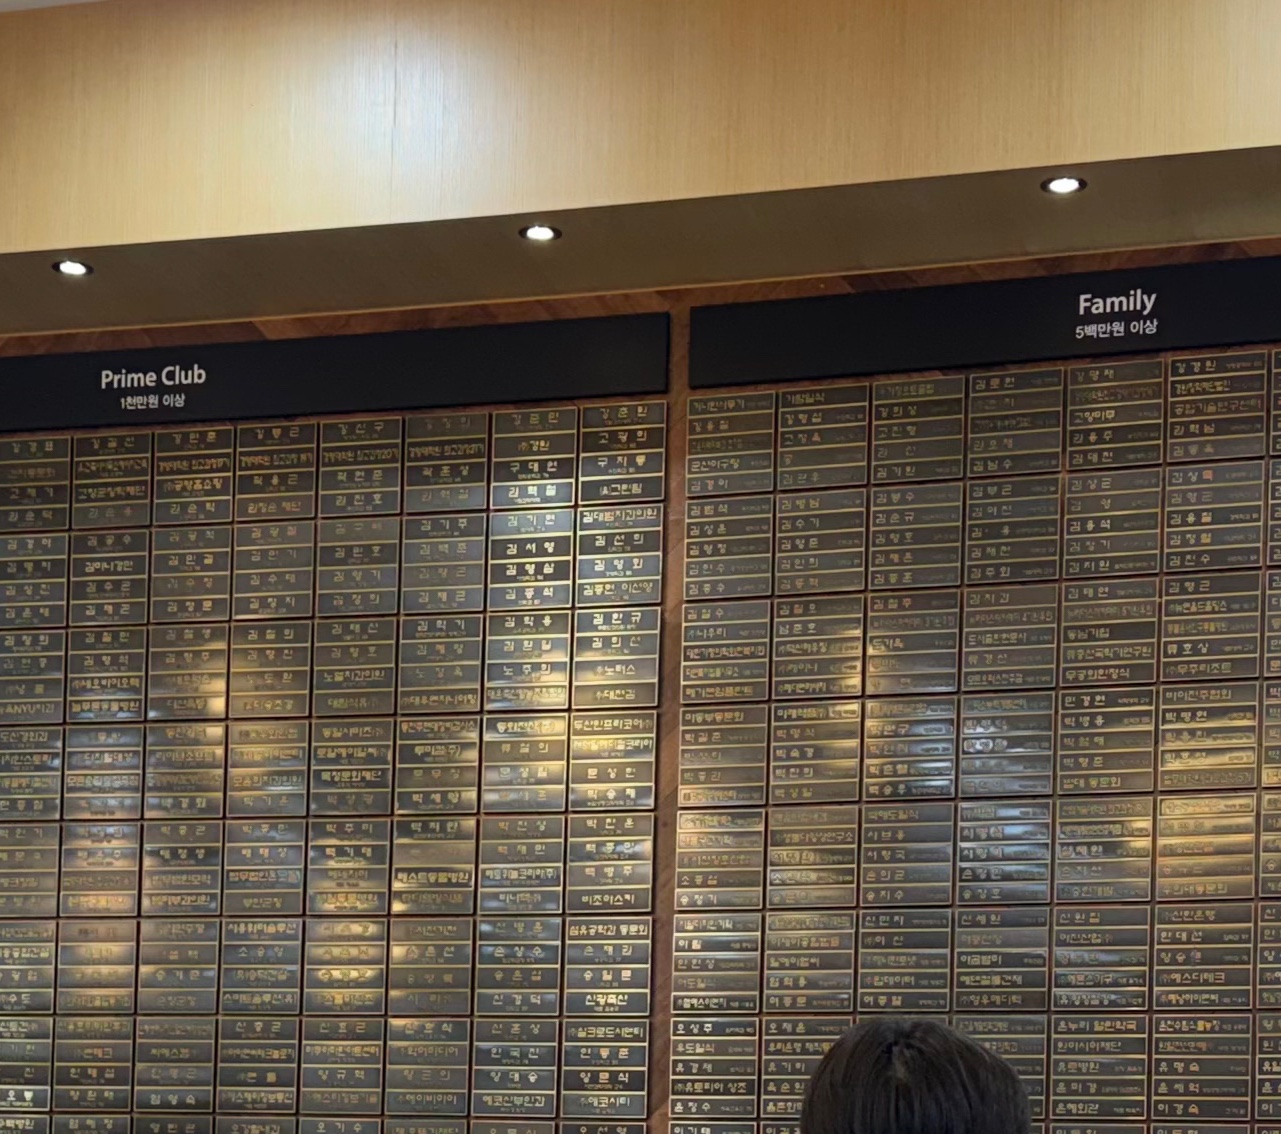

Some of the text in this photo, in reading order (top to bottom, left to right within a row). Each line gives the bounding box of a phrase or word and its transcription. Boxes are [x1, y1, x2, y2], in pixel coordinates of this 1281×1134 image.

[1078, 289, 1156, 316] Family
[1075, 319, 1158, 339] 5백만원 이상
[101, 365, 206, 389] Prime Club
[120, 393, 185, 410] 1천만원 이상
